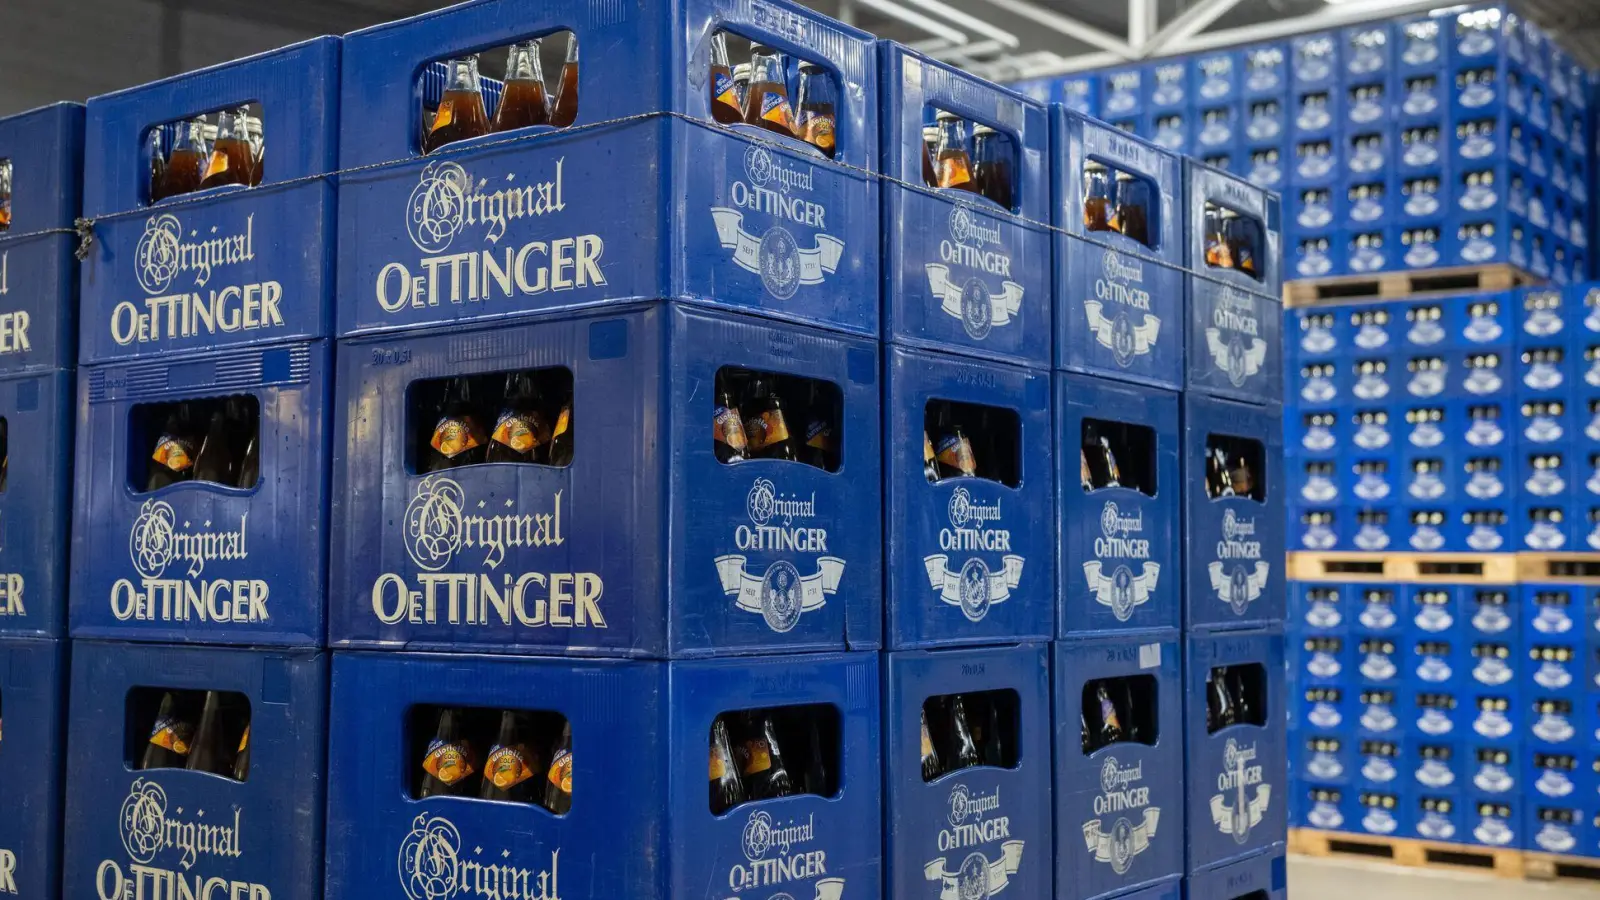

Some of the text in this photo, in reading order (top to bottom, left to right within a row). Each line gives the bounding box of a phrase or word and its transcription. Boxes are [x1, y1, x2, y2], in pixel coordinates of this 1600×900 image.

[743, 139, 814, 194] Original
[406, 155, 566, 254] Original
[731, 180, 827, 230] OETTINGER
[948, 200, 1001, 249] Original
[134, 212, 255, 295] Original
[376, 234, 608, 313] OETTINGER
[940, 239, 1011, 278] OETTINGER
[111, 280, 285, 346] OETTINGER
[1095, 279, 1150, 311] OETTINGER
[438, 419, 470, 434] Glorietta
[505, 413, 540, 429] Glorietta
[403, 475, 565, 571] Original
[746, 476, 816, 527] Original
[947, 485, 1002, 529] Original
[129, 498, 248, 580] Original
[734, 524, 828, 553] OETTINGER
[940, 528, 1012, 552] OETTINGER
[1094, 536, 1150, 558] OETTINGER
[110, 578, 270, 623] OETTINGER
[371, 571, 608, 629] OETTINGER
[434, 743, 468, 758] Glorietta
[491, 748, 524, 763] Glorietta
[1100, 755, 1143, 795] Original
[1217, 765, 1263, 791] OETTGER
[119, 776, 242, 870] Original
[947, 783, 1000, 828] Original
[1093, 786, 1150, 816] OETTINGER
[398, 811, 562, 900] Original
[742, 809, 815, 862] Original
[938, 816, 1011, 852] OETTINGER
[729, 850, 828, 892] OETTINGER
